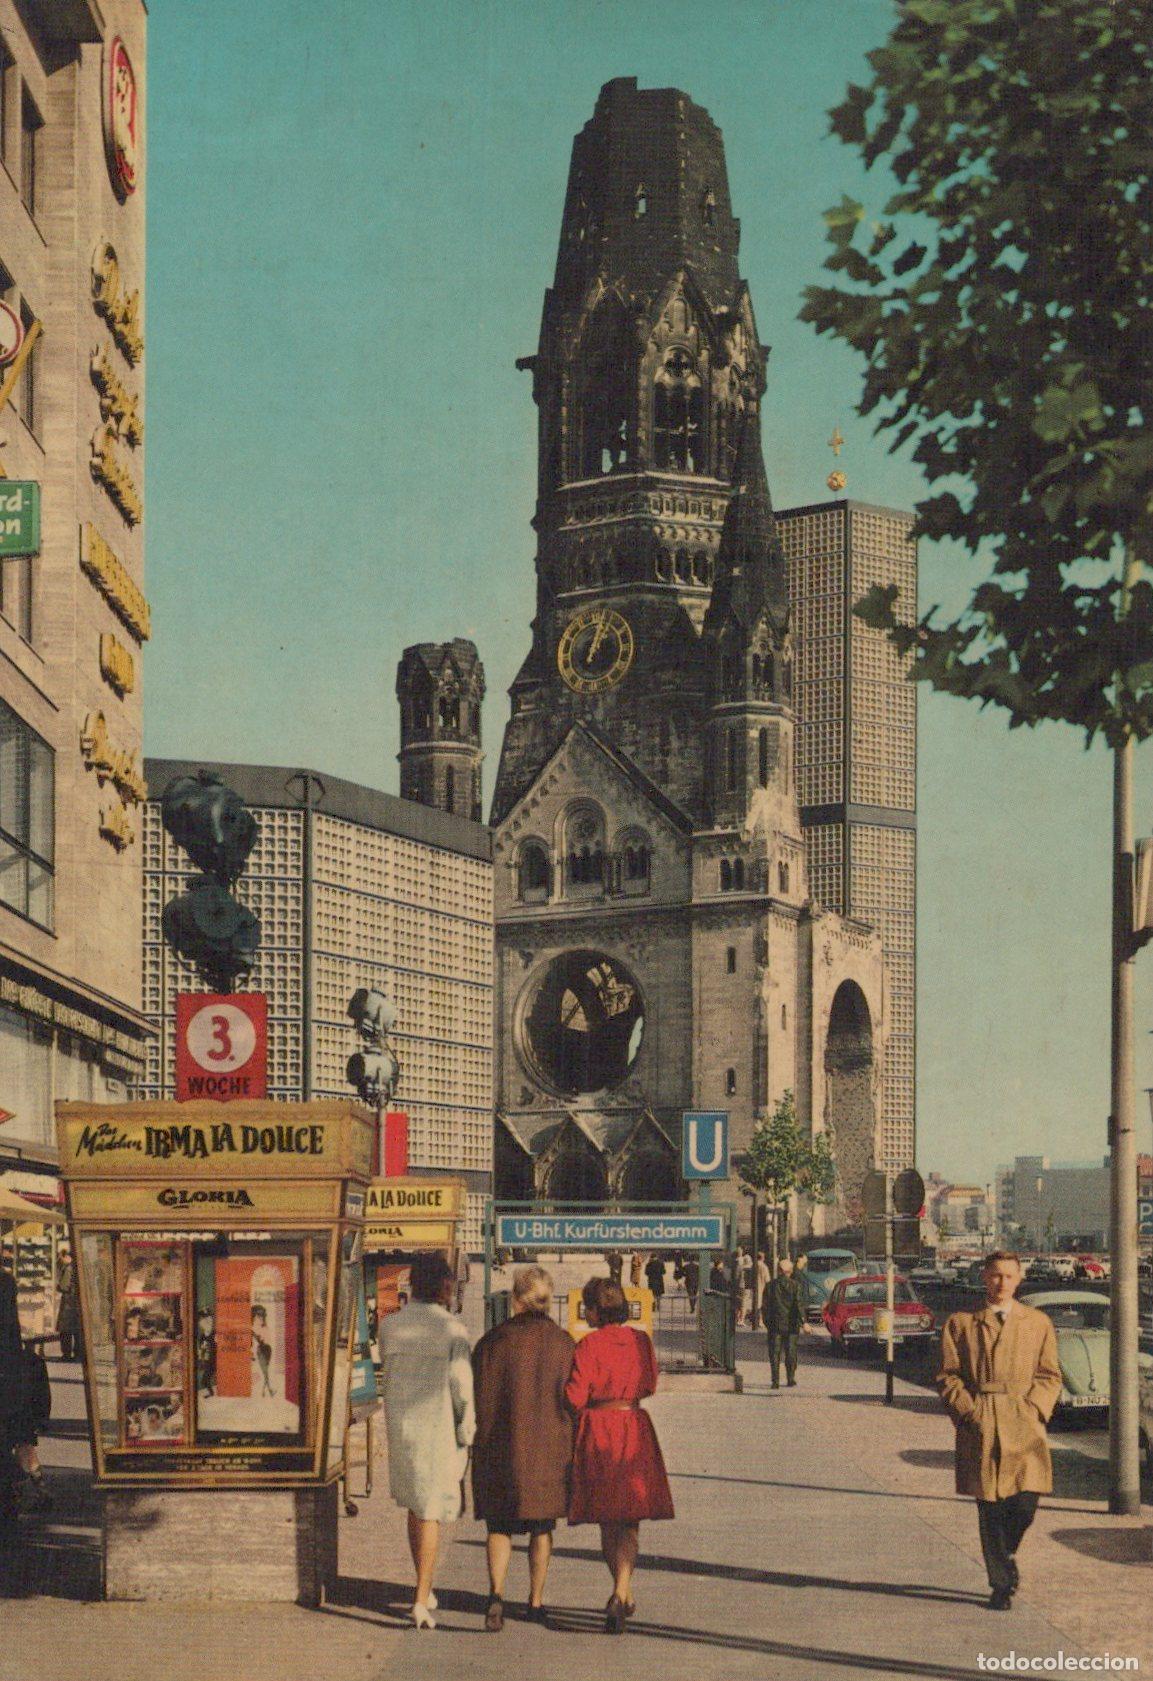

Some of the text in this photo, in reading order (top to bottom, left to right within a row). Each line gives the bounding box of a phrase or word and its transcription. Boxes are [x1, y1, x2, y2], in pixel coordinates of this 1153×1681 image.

[207, 1015, 235, 1061] 3.
[188, 1077, 249, 1094] WOCHE
[144, 1125, 209, 1158] IRMA
[239, 1125, 324, 1154] DOUCE
[689, 1120, 723, 1172] U
[157, 1188, 255, 1207] GLORIA
[381, 1190, 394, 1208] LA
[397, 1190, 442, 1207] DOUCE
[364, 1227, 403, 1238] ORIA
[565, 1222, 707, 1239] Kurfürstendamm
